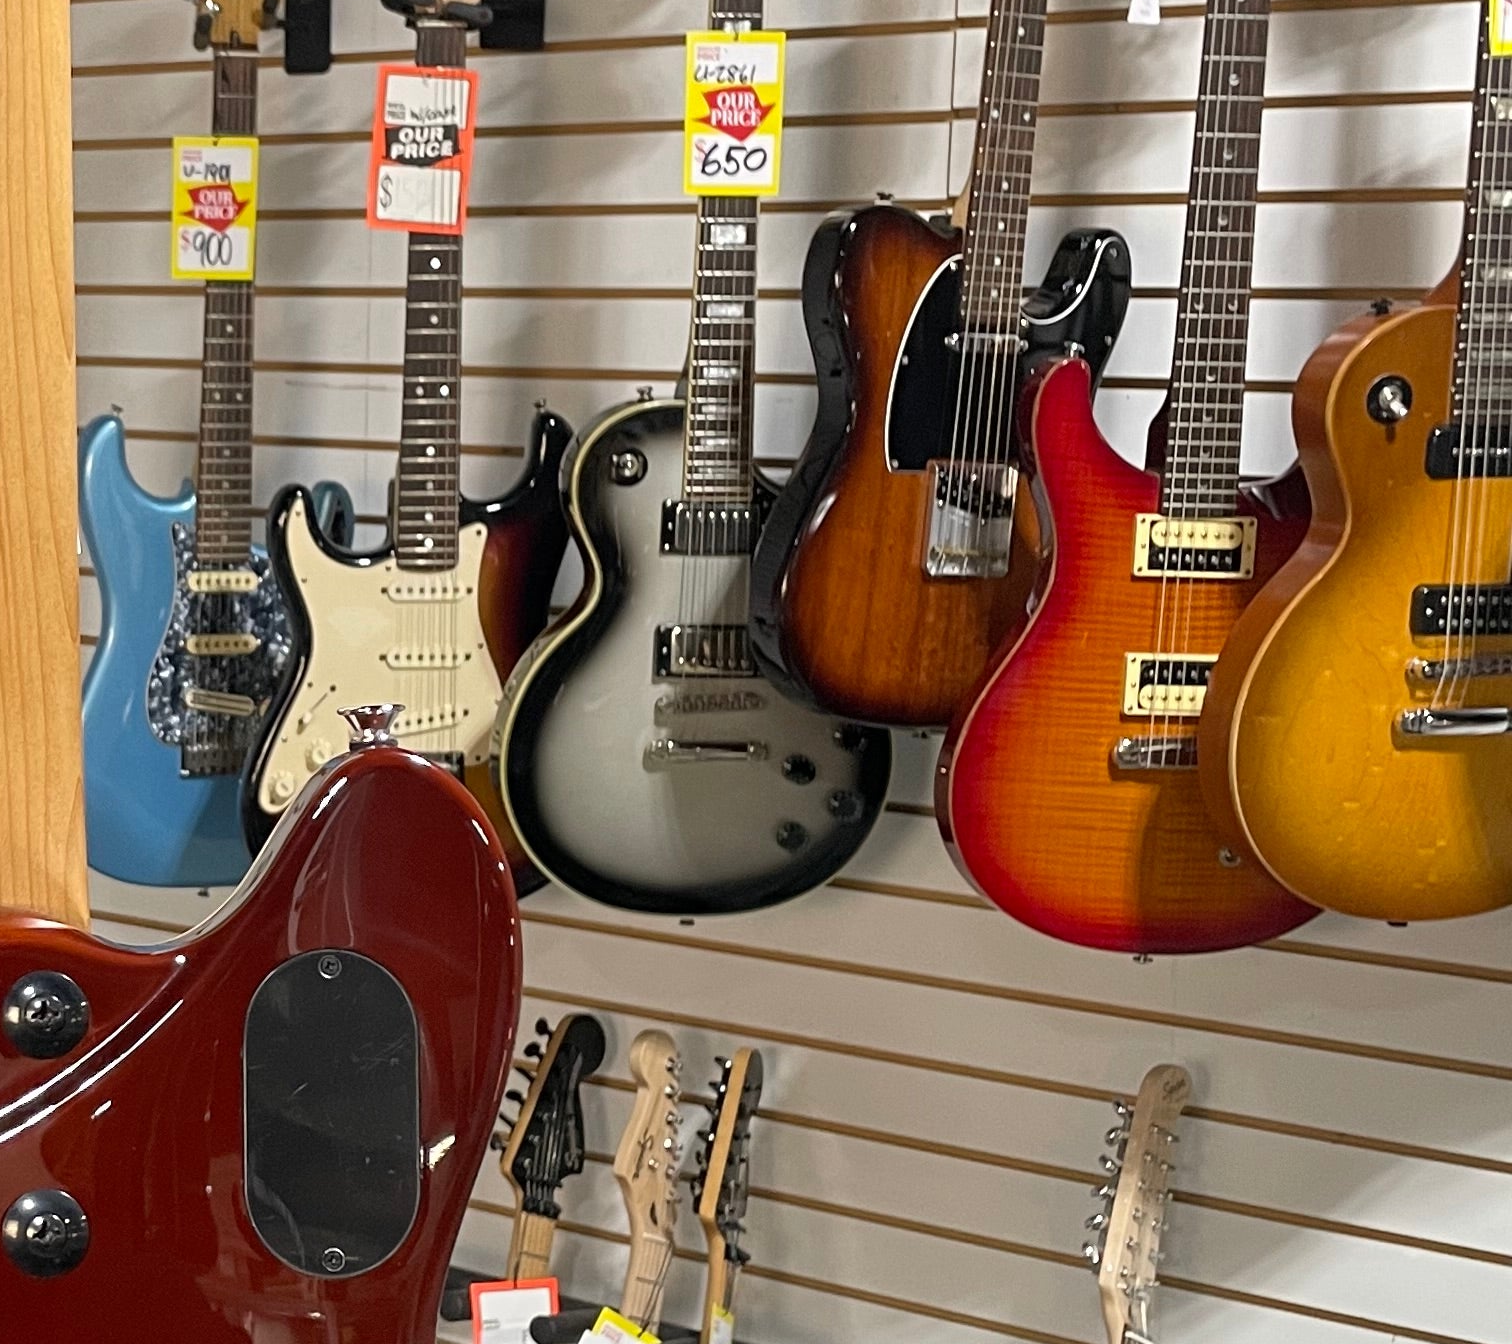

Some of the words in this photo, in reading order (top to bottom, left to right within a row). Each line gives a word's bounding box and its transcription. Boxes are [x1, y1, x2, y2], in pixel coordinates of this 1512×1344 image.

[716, 91, 755, 109] OUR
[710, 108, 762, 127] PRICE
[398, 126, 445, 143] OUR
[390, 140, 454, 160] PRICE
[198, 189, 234, 206] OUR
[194, 204, 239, 220] PRICE
